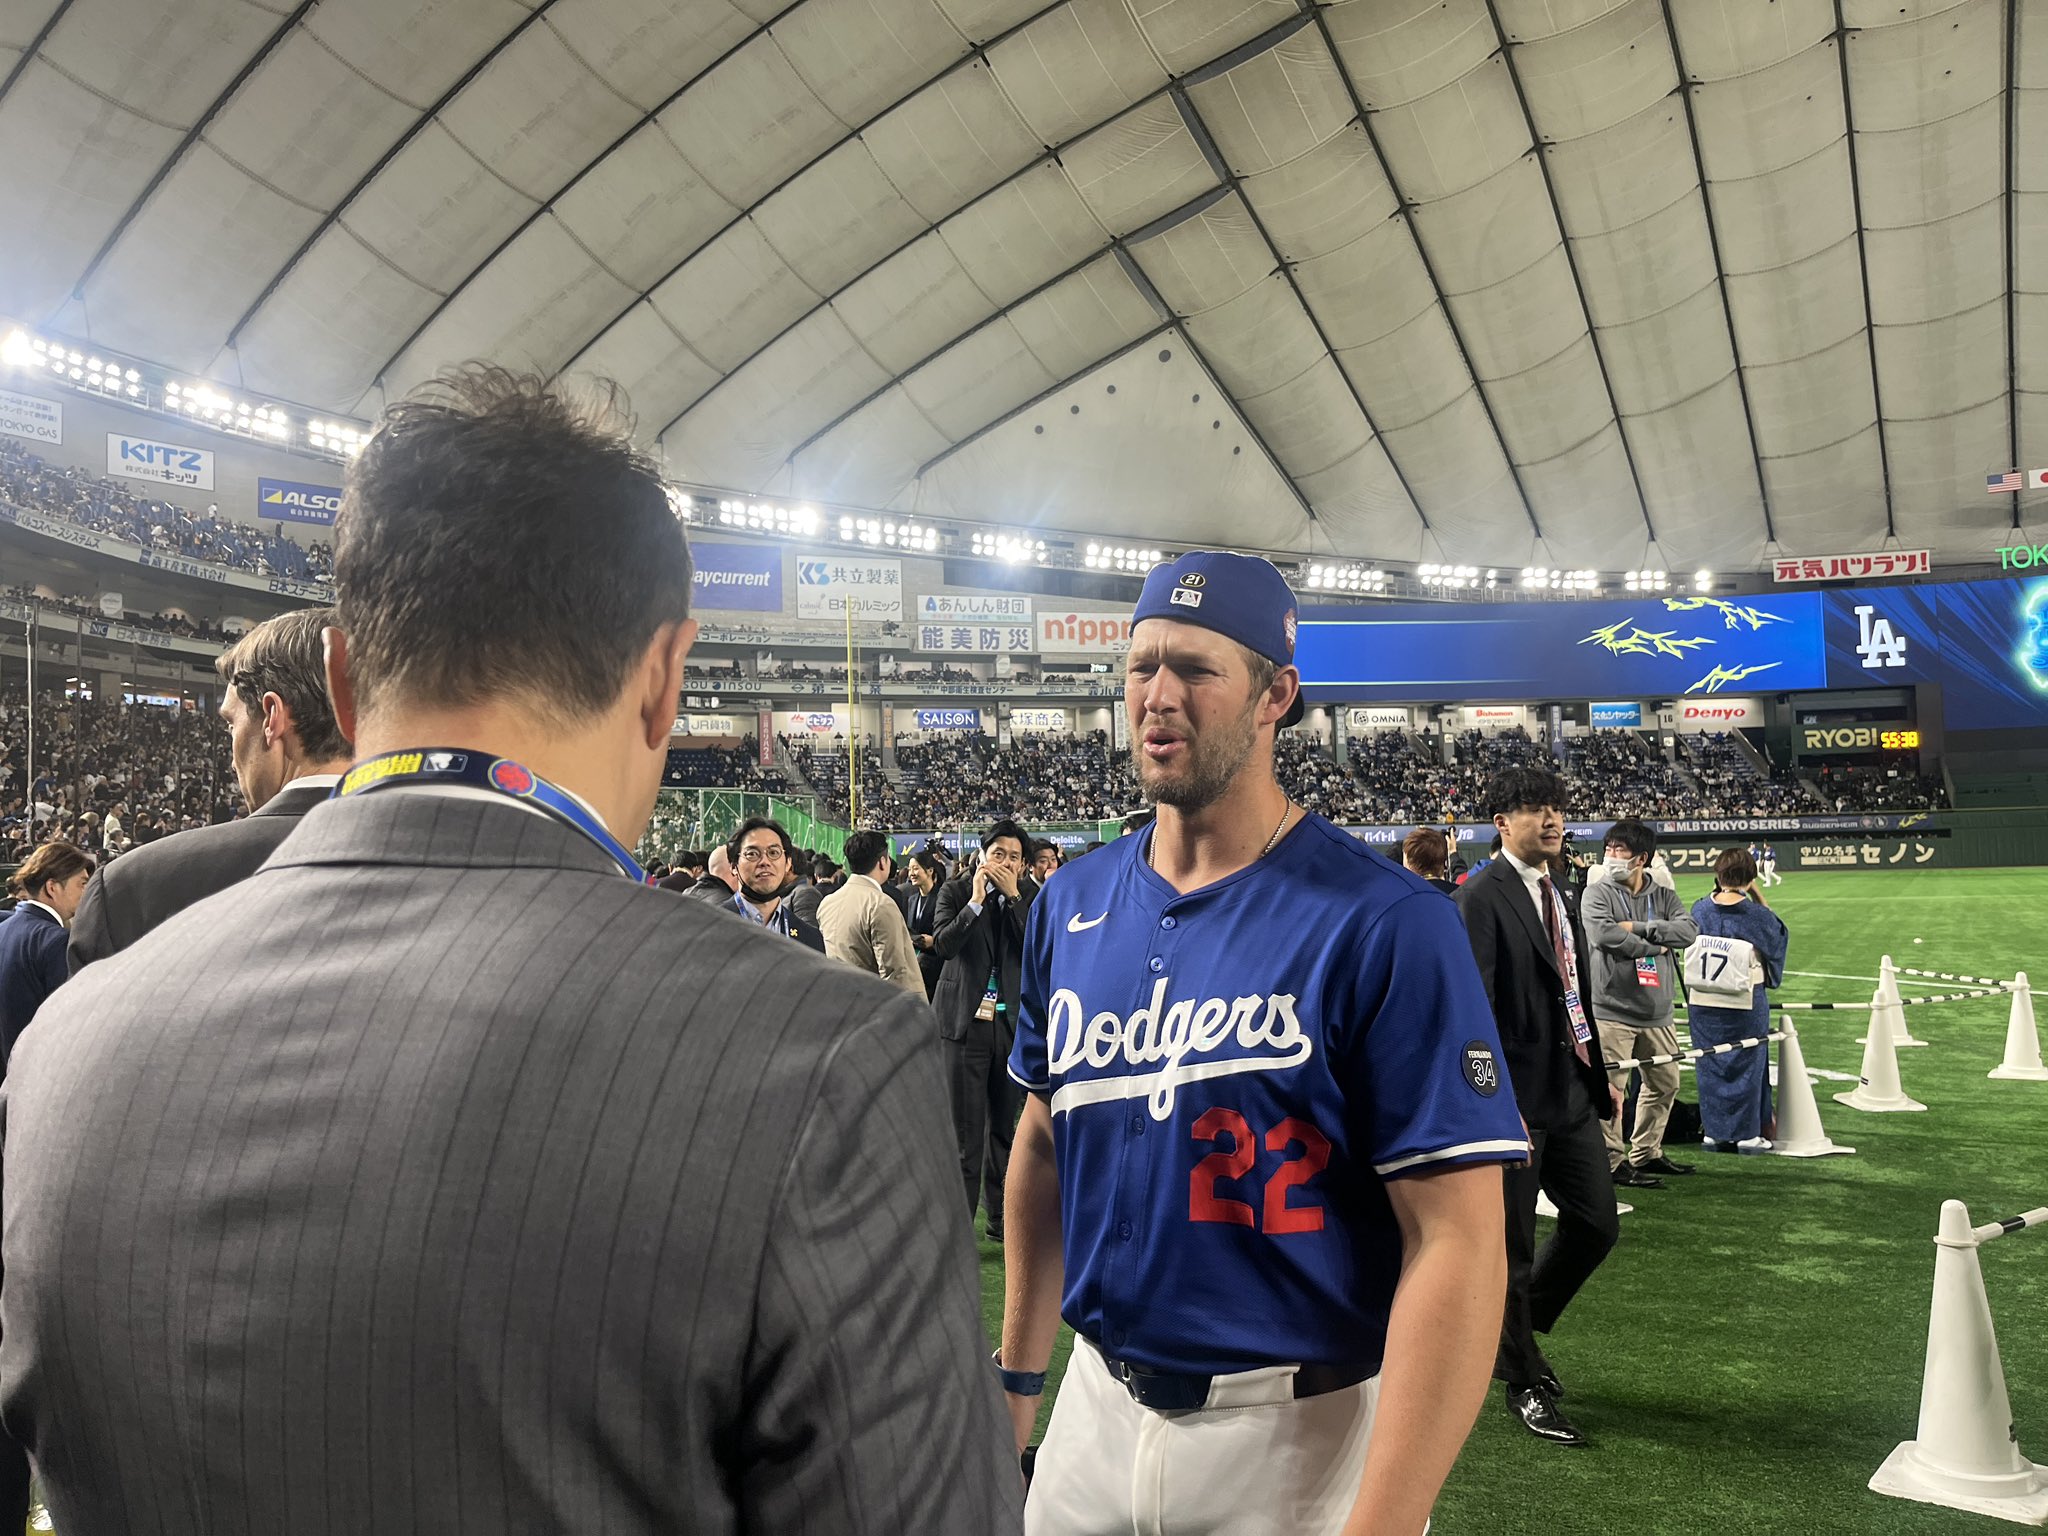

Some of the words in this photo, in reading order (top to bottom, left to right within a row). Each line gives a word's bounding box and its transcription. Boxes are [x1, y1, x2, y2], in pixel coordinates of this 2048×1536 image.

[37, 426, 57, 438] GAS
[121, 440, 202, 471] KITZ
[160, 469, 198, 485] キッツ
[1776, 551, 1928, 581] 元気ハツラツ!
[1995, 544, 2048, 570] TOK
[692, 569, 771, 587] aycurrent
[832, 566, 900, 585] 共立製薬
[1185, 574, 1201, 585] 21
[938, 597, 1025, 614] あんしん財団
[921, 626, 1030, 651] 能美防災
[1855, 605, 1906, 668] LA
[922, 712, 975, 726] SAISON
[1371, 715, 1406, 723] OMNIA
[1683, 707, 1746, 721] Denyo
[1804, 728, 1877, 748] RYOBI
[1676, 821, 1700, 832] MLB
[1701, 820, 1748, 832] TOKYO
[1750, 819, 1800, 830] SERIES
[1860, 843, 1935, 863] セノン
[1701, 938, 1732, 953] OHTANI
[1700, 951, 1728, 981] 17
[1046, 978, 1312, 1121] Dodgers
[1471, 1059, 1496, 1087] 34
[1188, 1106, 1331, 1234] 22
